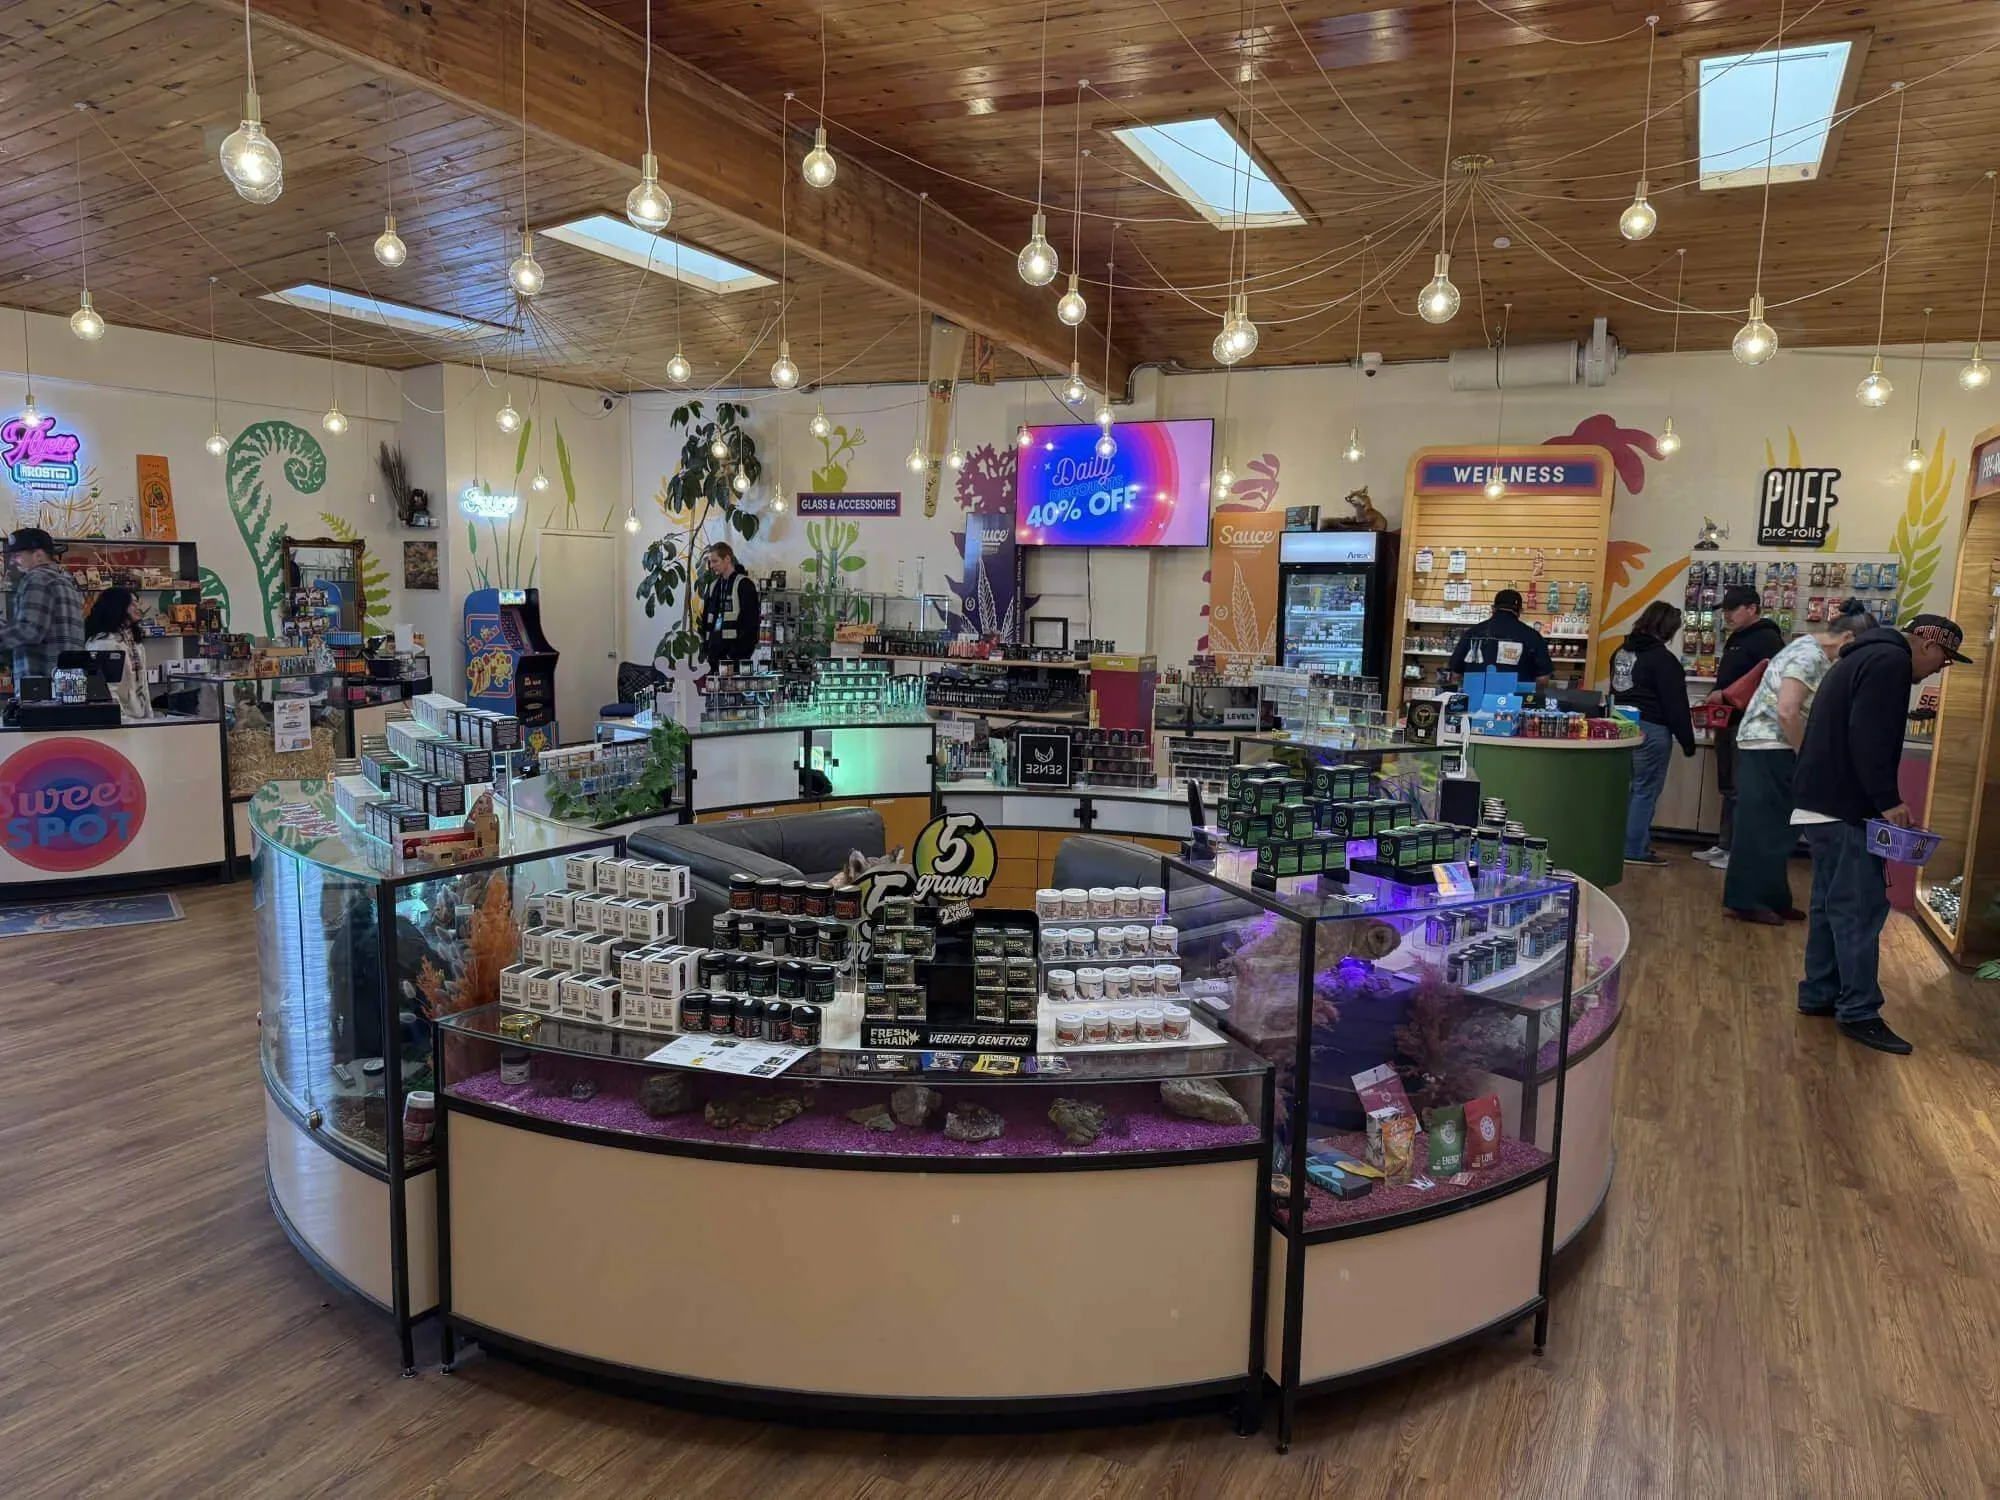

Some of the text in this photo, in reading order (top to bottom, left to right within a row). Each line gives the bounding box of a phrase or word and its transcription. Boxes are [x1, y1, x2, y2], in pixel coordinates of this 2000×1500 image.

[1052, 454, 1115, 486] Daily
[1453, 466, 1565, 483] WELLNESS
[801, 499, 897, 510] GLASS & ACCESSORIES
[1026, 486, 1138, 528] 40% OFF
[1763, 471, 1838, 528] PUFF
[974, 528, 1010, 543] auce
[1219, 525, 1279, 545] Sauce
[1762, 527, 1822, 539] pre-rolls
[1226, 712, 1251, 721] LEVEL
[0, 767, 138, 819] Sweet
[7, 811, 133, 850] SPOT
[935, 815, 976, 873] 5
[912, 874, 986, 902] grams
[870, 1028, 910, 1038] FRESH
[870, 1036, 910, 1046] STRAIN
[928, 1032, 1029, 1047] VERIFIED GENETICS
